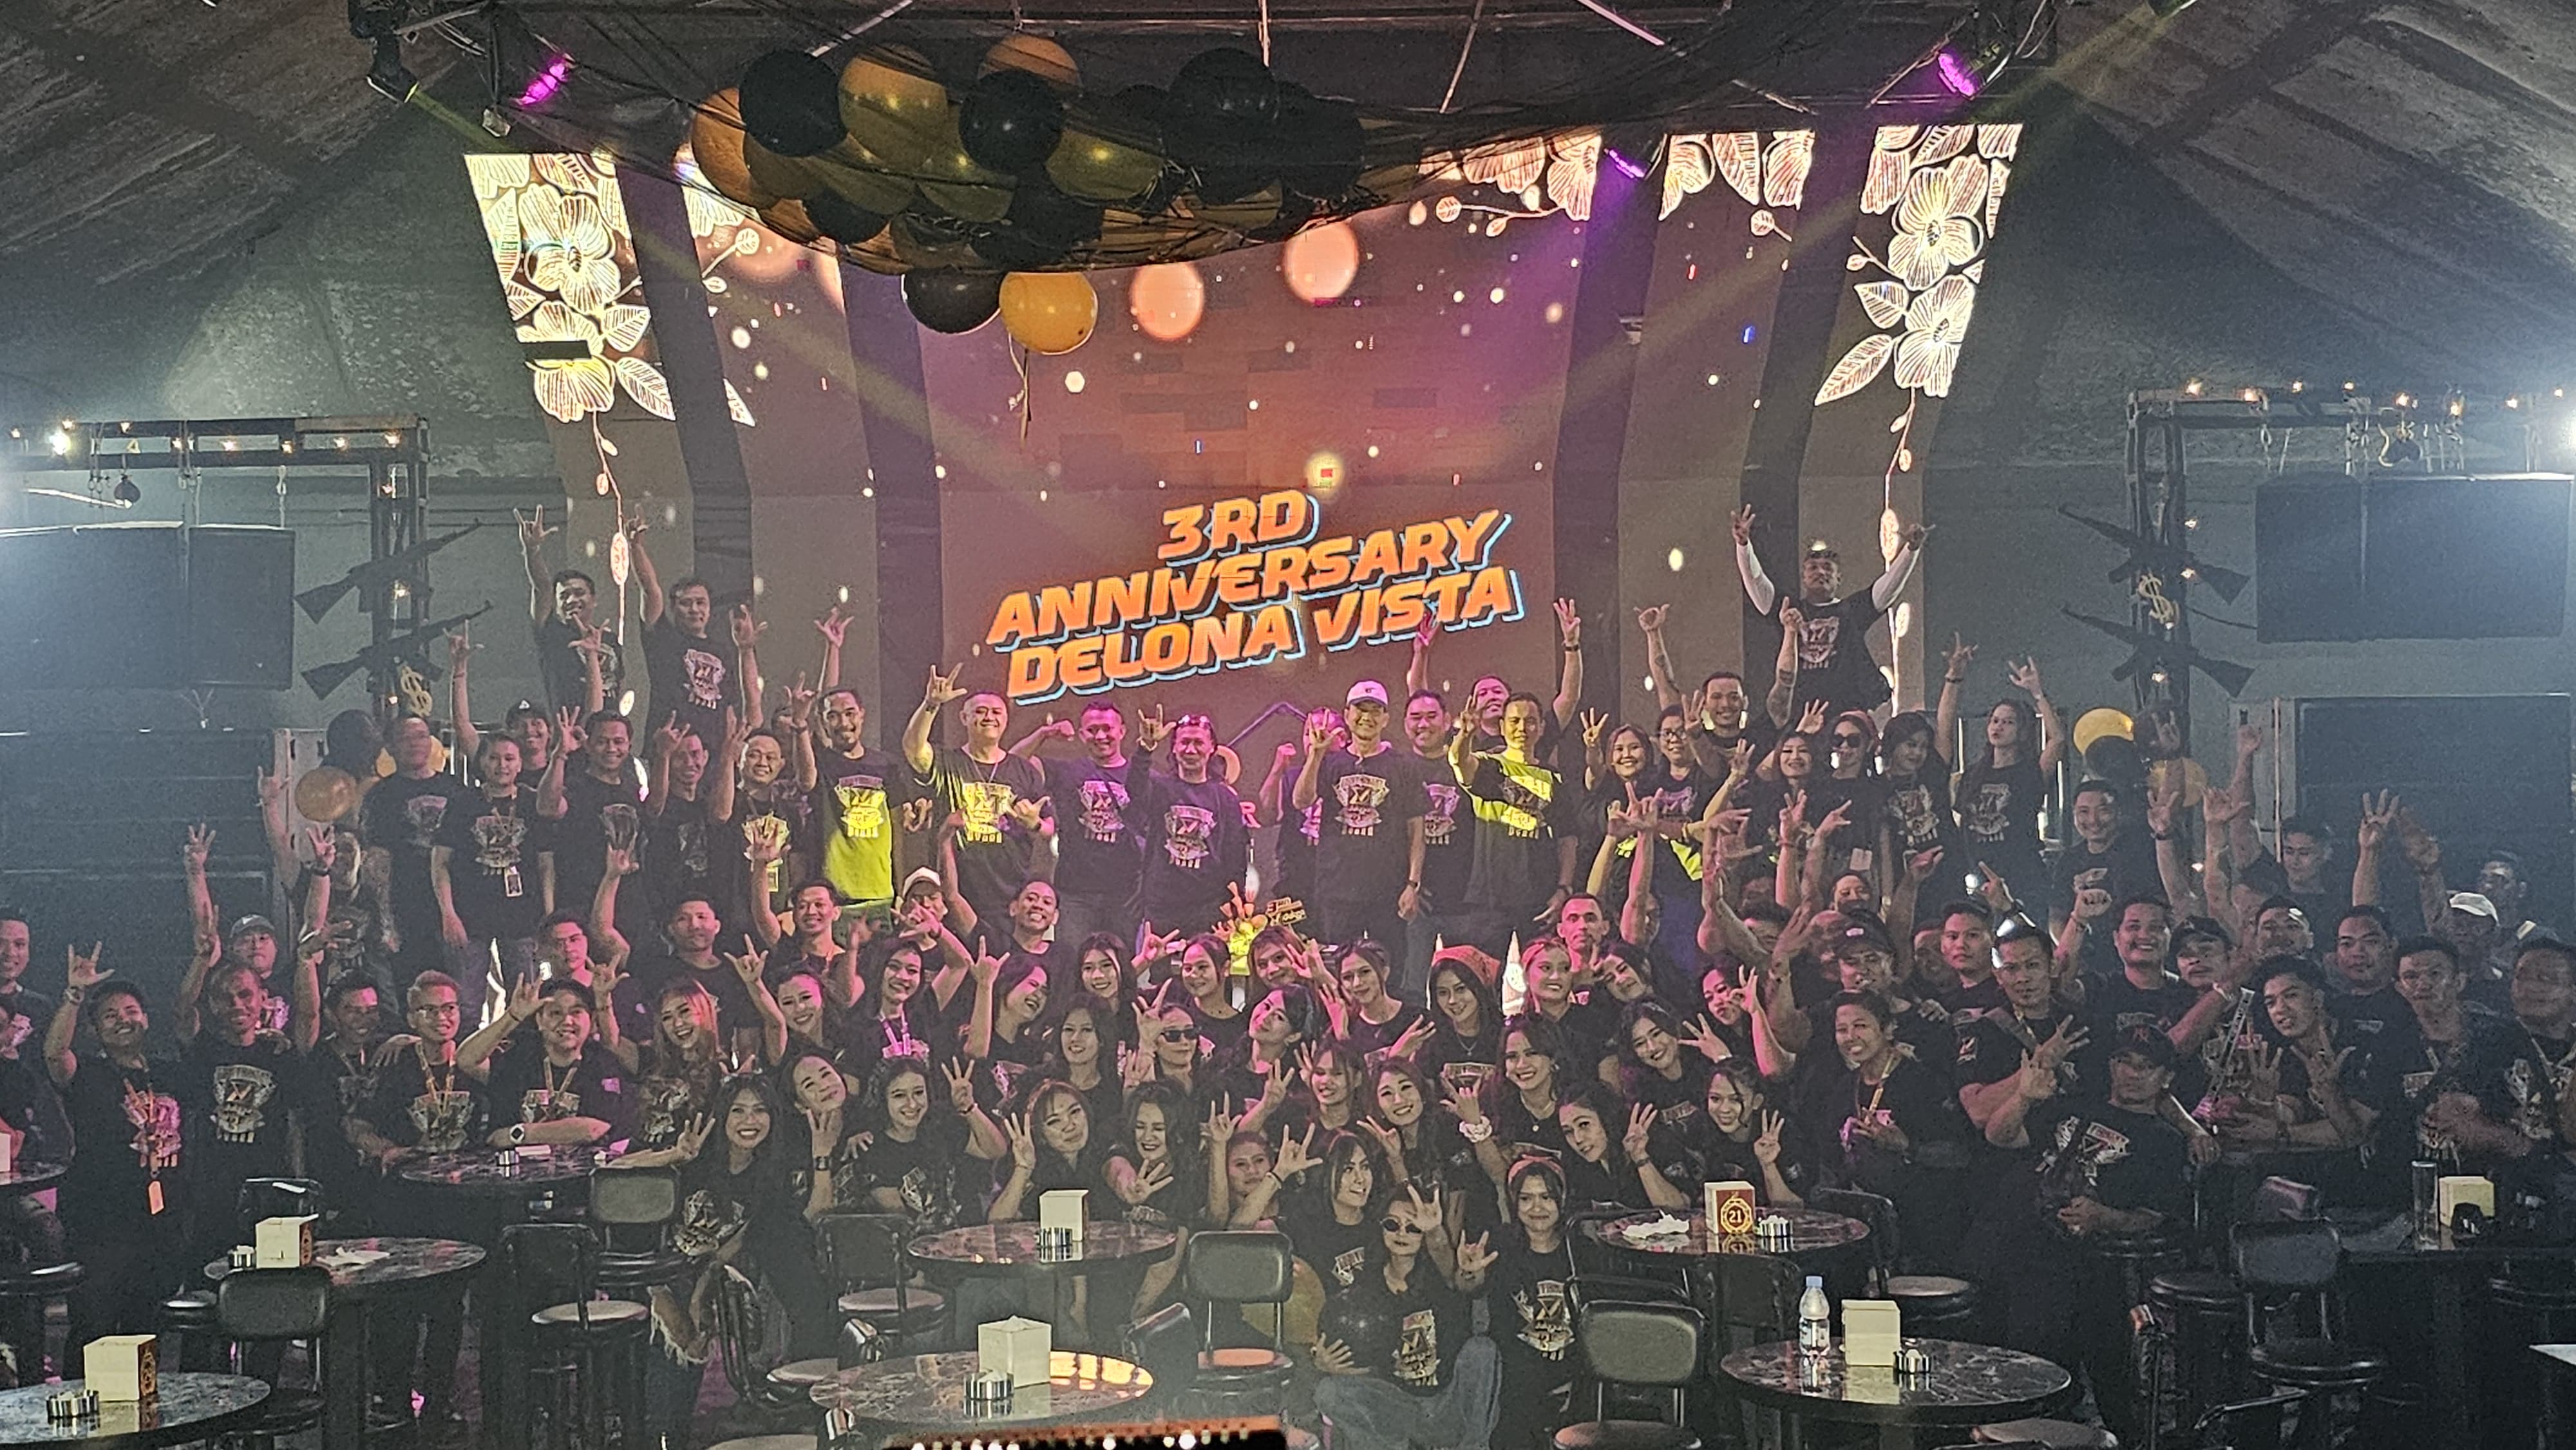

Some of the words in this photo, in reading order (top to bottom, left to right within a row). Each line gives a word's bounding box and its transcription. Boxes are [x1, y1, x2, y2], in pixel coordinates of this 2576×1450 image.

[985, 508, 1508, 650] ANNIVERSARY
[1159, 489, 1316, 565] 3RD
[1007, 603, 1305, 703] DELONA
[1312, 565, 1522, 645] VISTA
[1728, 1209, 1743, 1224] 21
